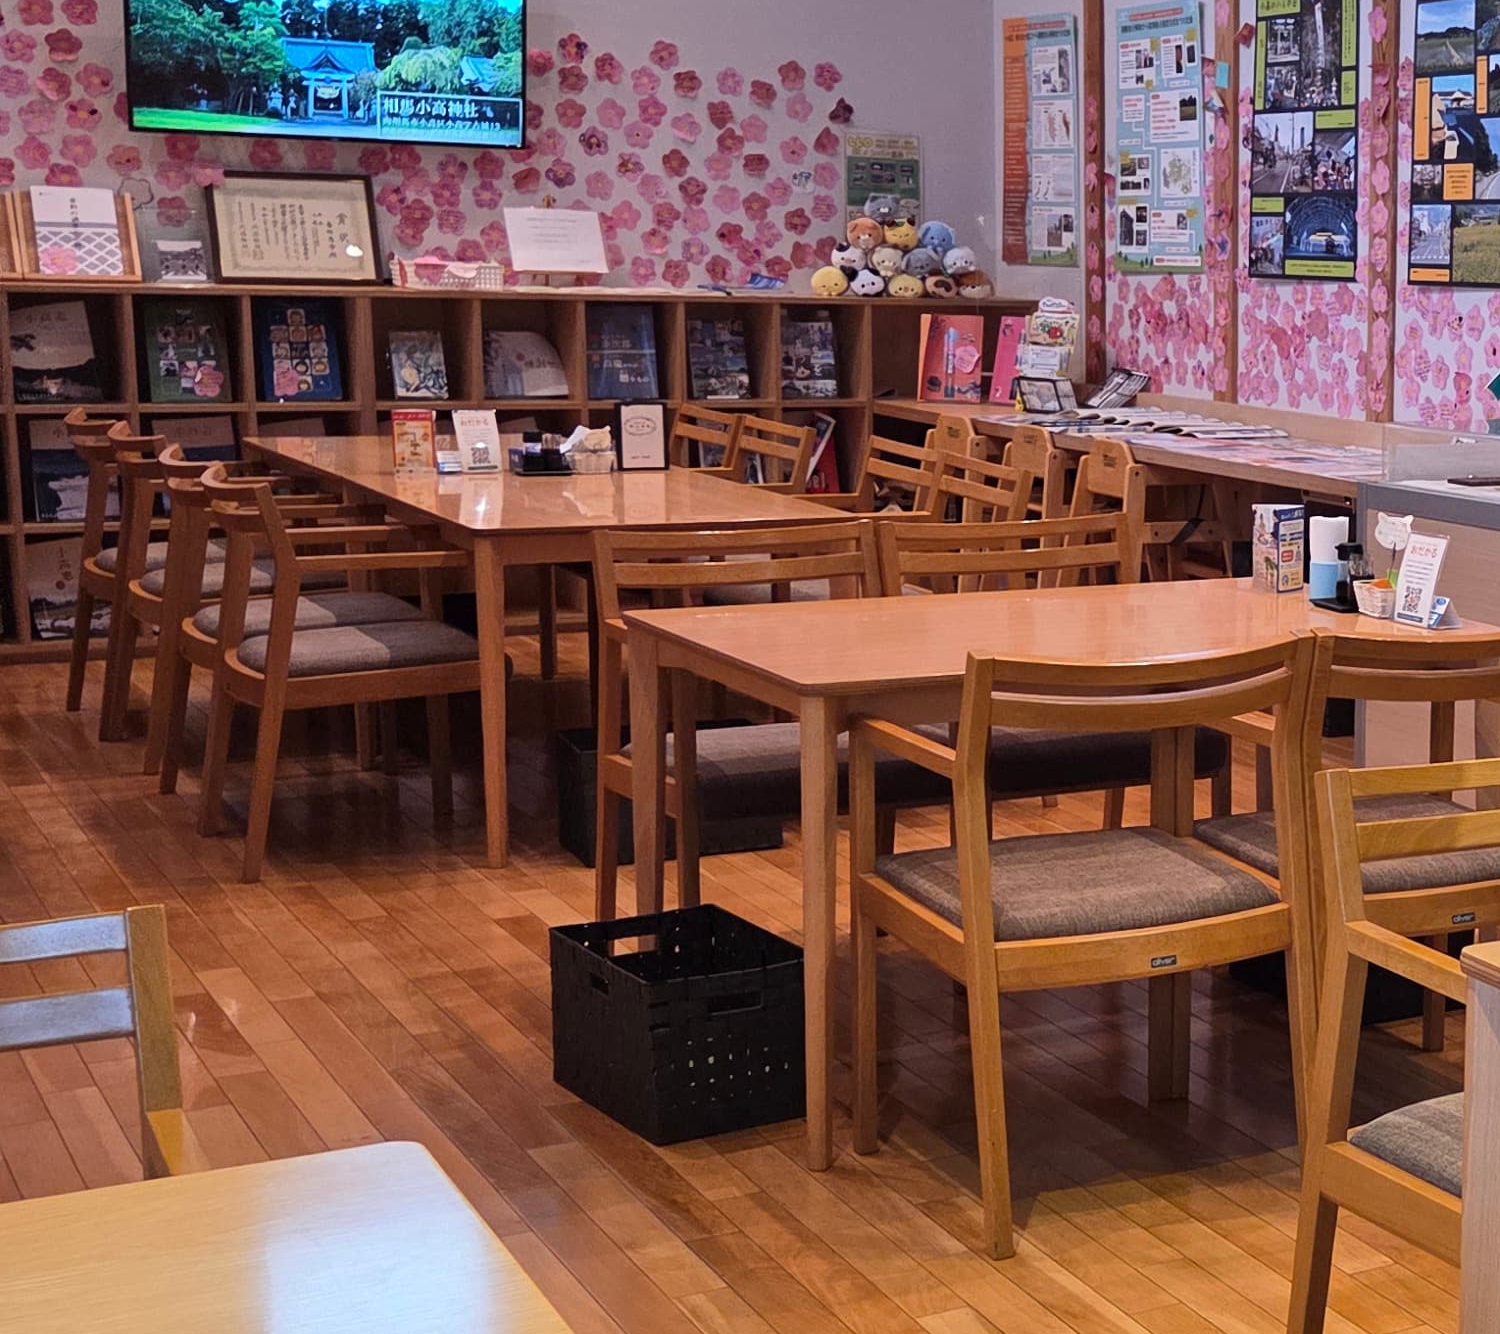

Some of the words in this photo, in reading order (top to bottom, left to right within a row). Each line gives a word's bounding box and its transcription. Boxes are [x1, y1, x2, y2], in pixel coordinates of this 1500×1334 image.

[383, 97, 479, 118] 相馬小高神社
